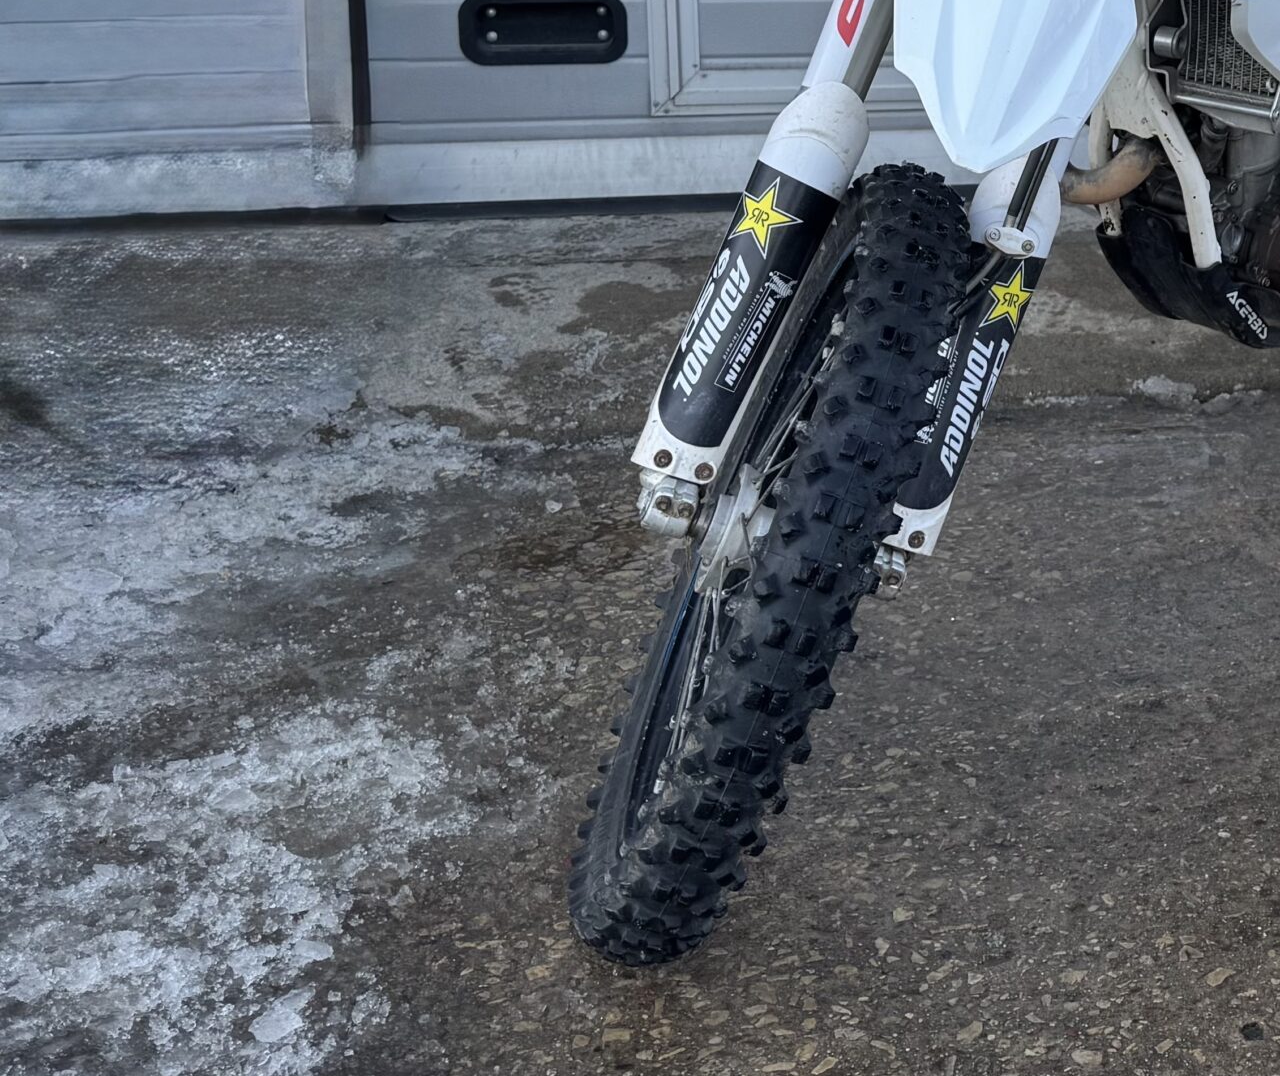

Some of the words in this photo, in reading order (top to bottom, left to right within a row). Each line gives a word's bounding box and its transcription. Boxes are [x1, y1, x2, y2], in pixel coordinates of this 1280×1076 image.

[673, 255, 750, 397] ADDINOL
[724, 296, 776, 388] MICHELIN
[1226, 290, 1267, 340] ACERBIS
[940, 338, 995, 478] ADDINOL
